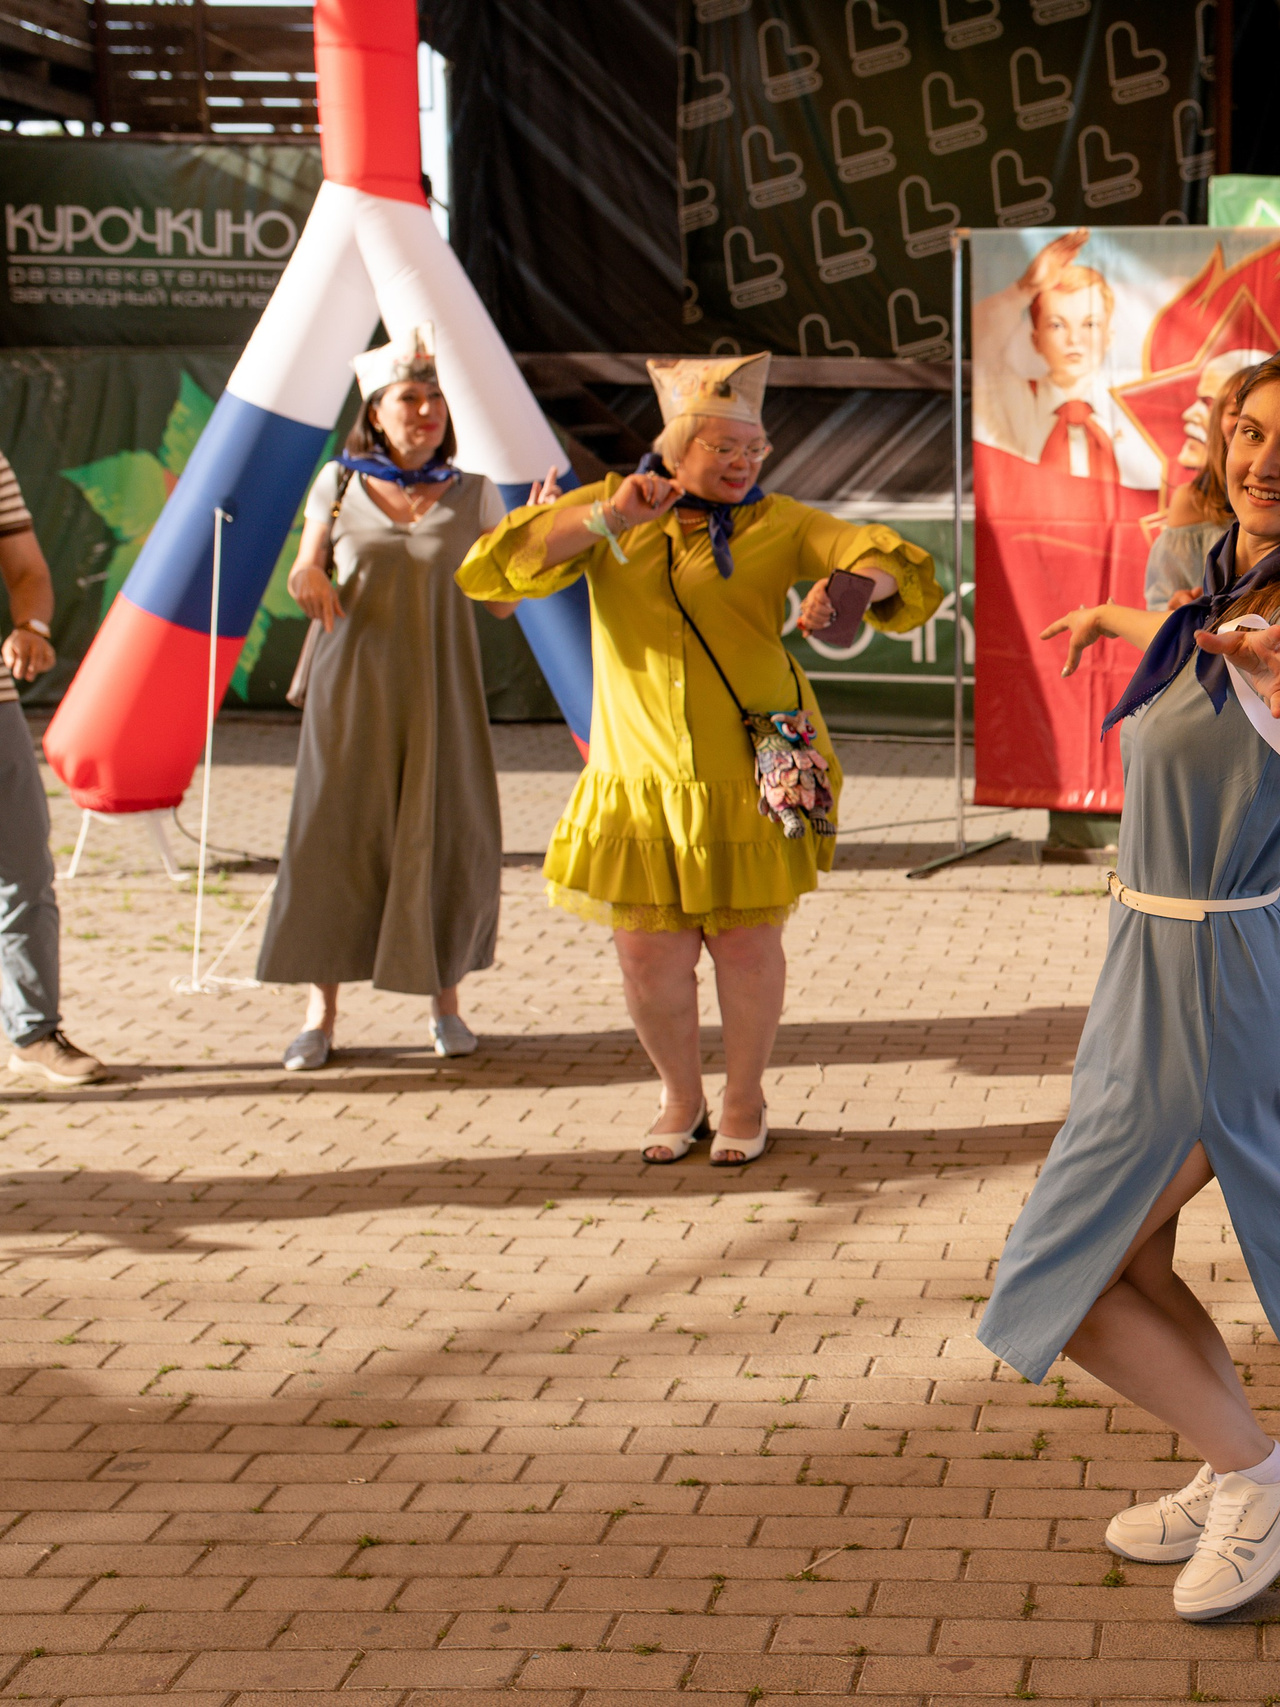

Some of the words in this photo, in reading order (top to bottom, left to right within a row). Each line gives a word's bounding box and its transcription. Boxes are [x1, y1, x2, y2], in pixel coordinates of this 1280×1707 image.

[5, 203, 298, 259] КУРОЧКИНО
[7, 266, 281, 290] развлекательны
[170, 290, 272, 310] компле
